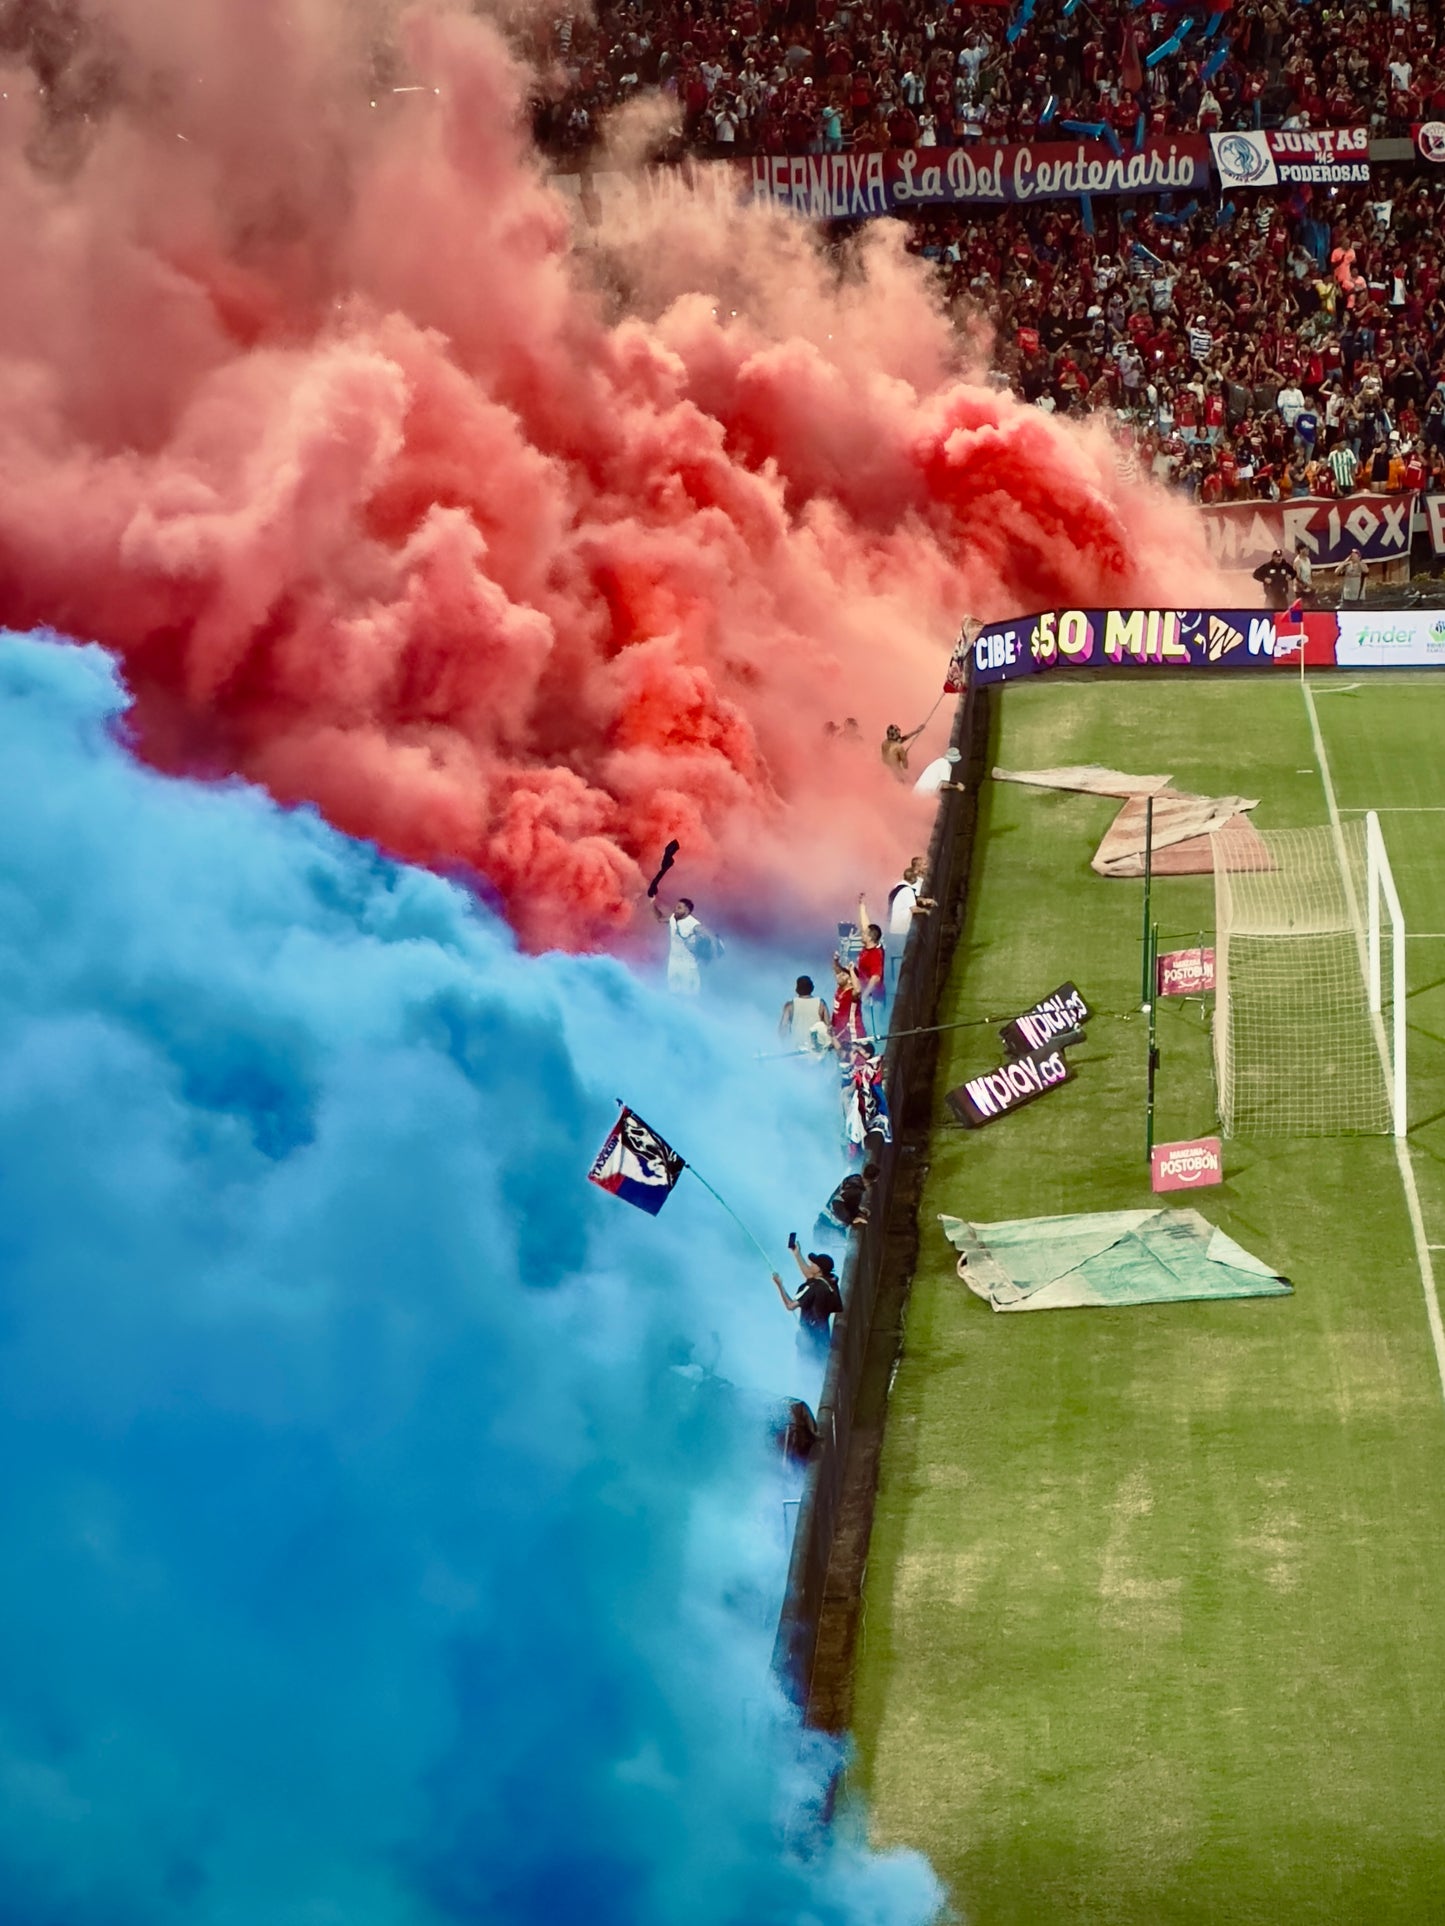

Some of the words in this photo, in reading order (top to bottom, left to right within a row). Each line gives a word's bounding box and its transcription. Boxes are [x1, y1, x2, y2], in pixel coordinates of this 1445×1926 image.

[1272, 128, 1368, 152] JUNTAS
[752, 152, 888, 217] HERMOXA
[893, 149, 944, 199] La
[947, 148, 1004, 198] Del
[1014, 145, 1195, 199] Centenario
[1279, 164, 1370, 182] PODEROSAS
[1104, 611, 1186, 655] MIL
